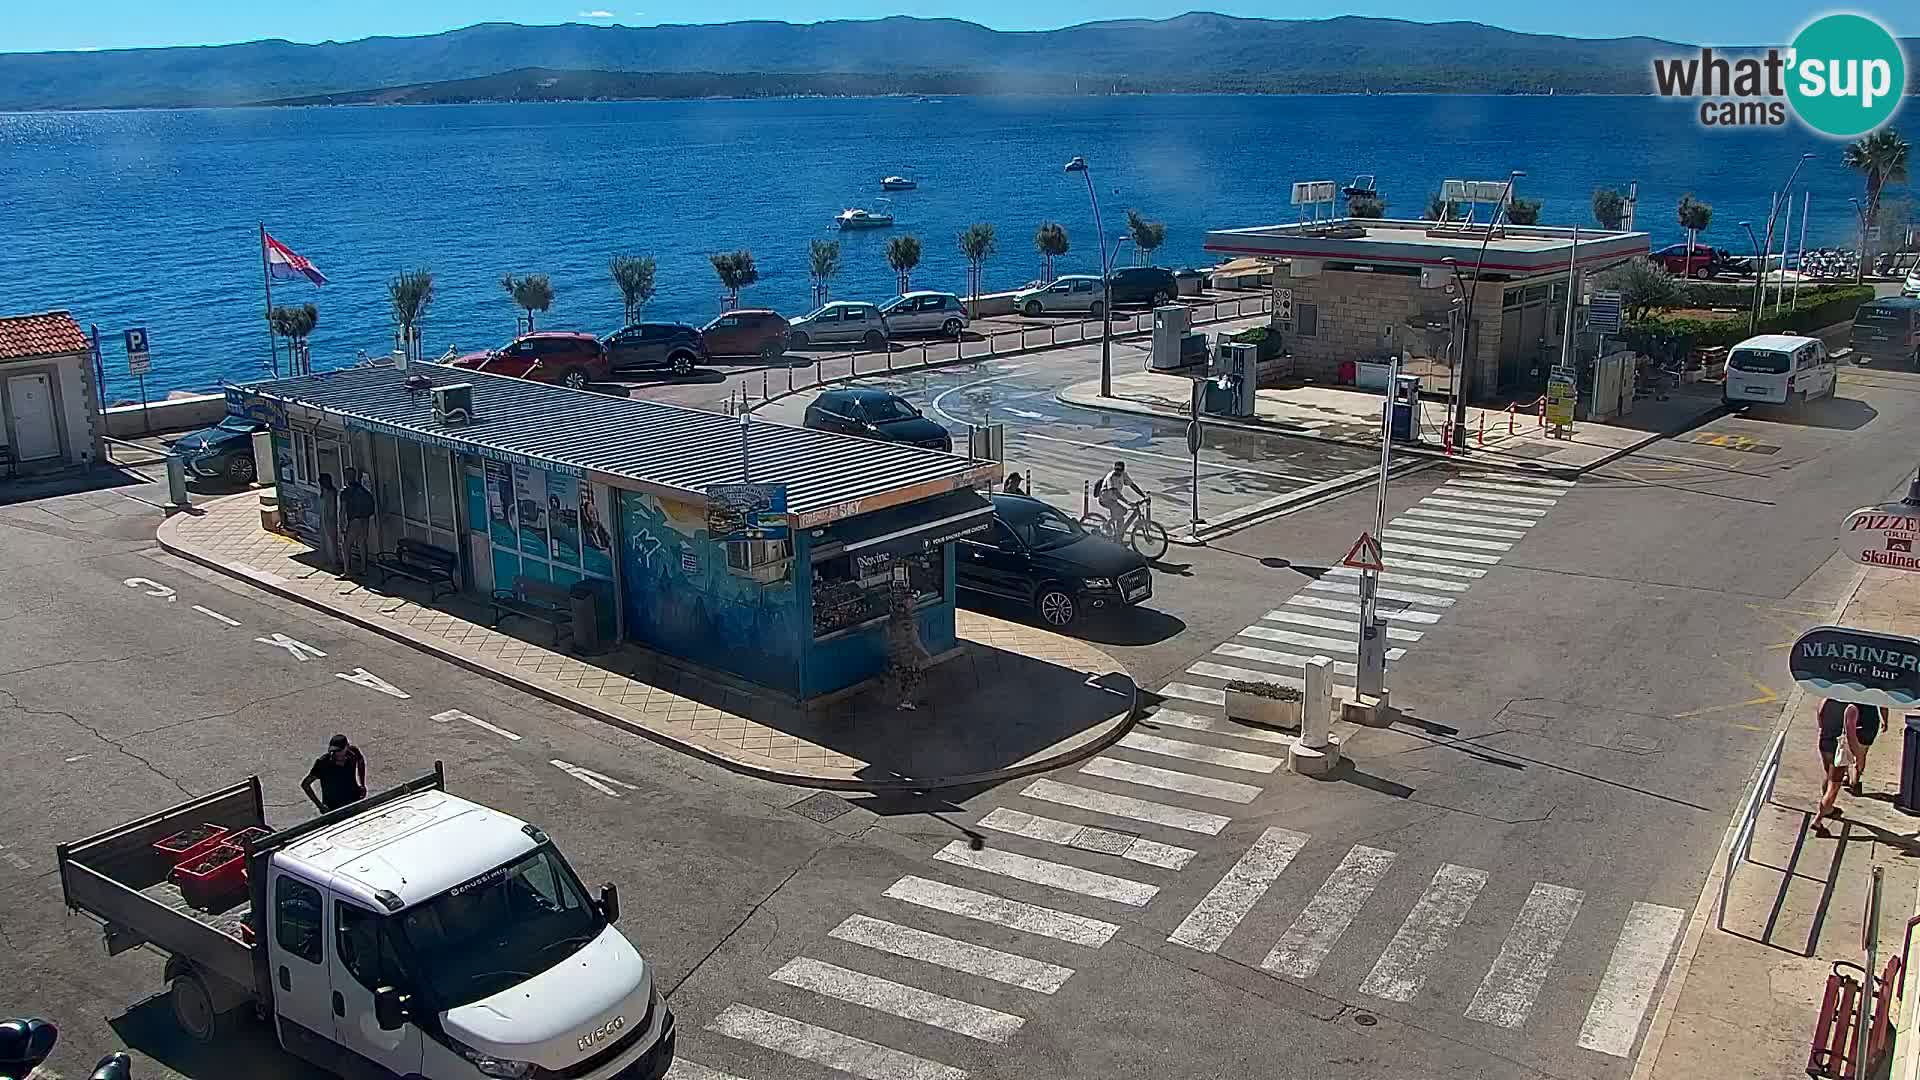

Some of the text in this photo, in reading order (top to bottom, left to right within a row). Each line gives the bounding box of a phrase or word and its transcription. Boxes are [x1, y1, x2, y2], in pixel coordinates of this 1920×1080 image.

[130, 331, 142, 350] P
[495, 450, 526, 465] STATION
[530, 458, 554, 472] TICKET
[557, 465, 582, 477] OFFICE
[1850, 515, 1920, 532] PIZZE
[1802, 642, 1920, 674] MARINER
[1830, 661, 1899, 681] caffe bar
[577, 1015, 626, 1052] IVECO
